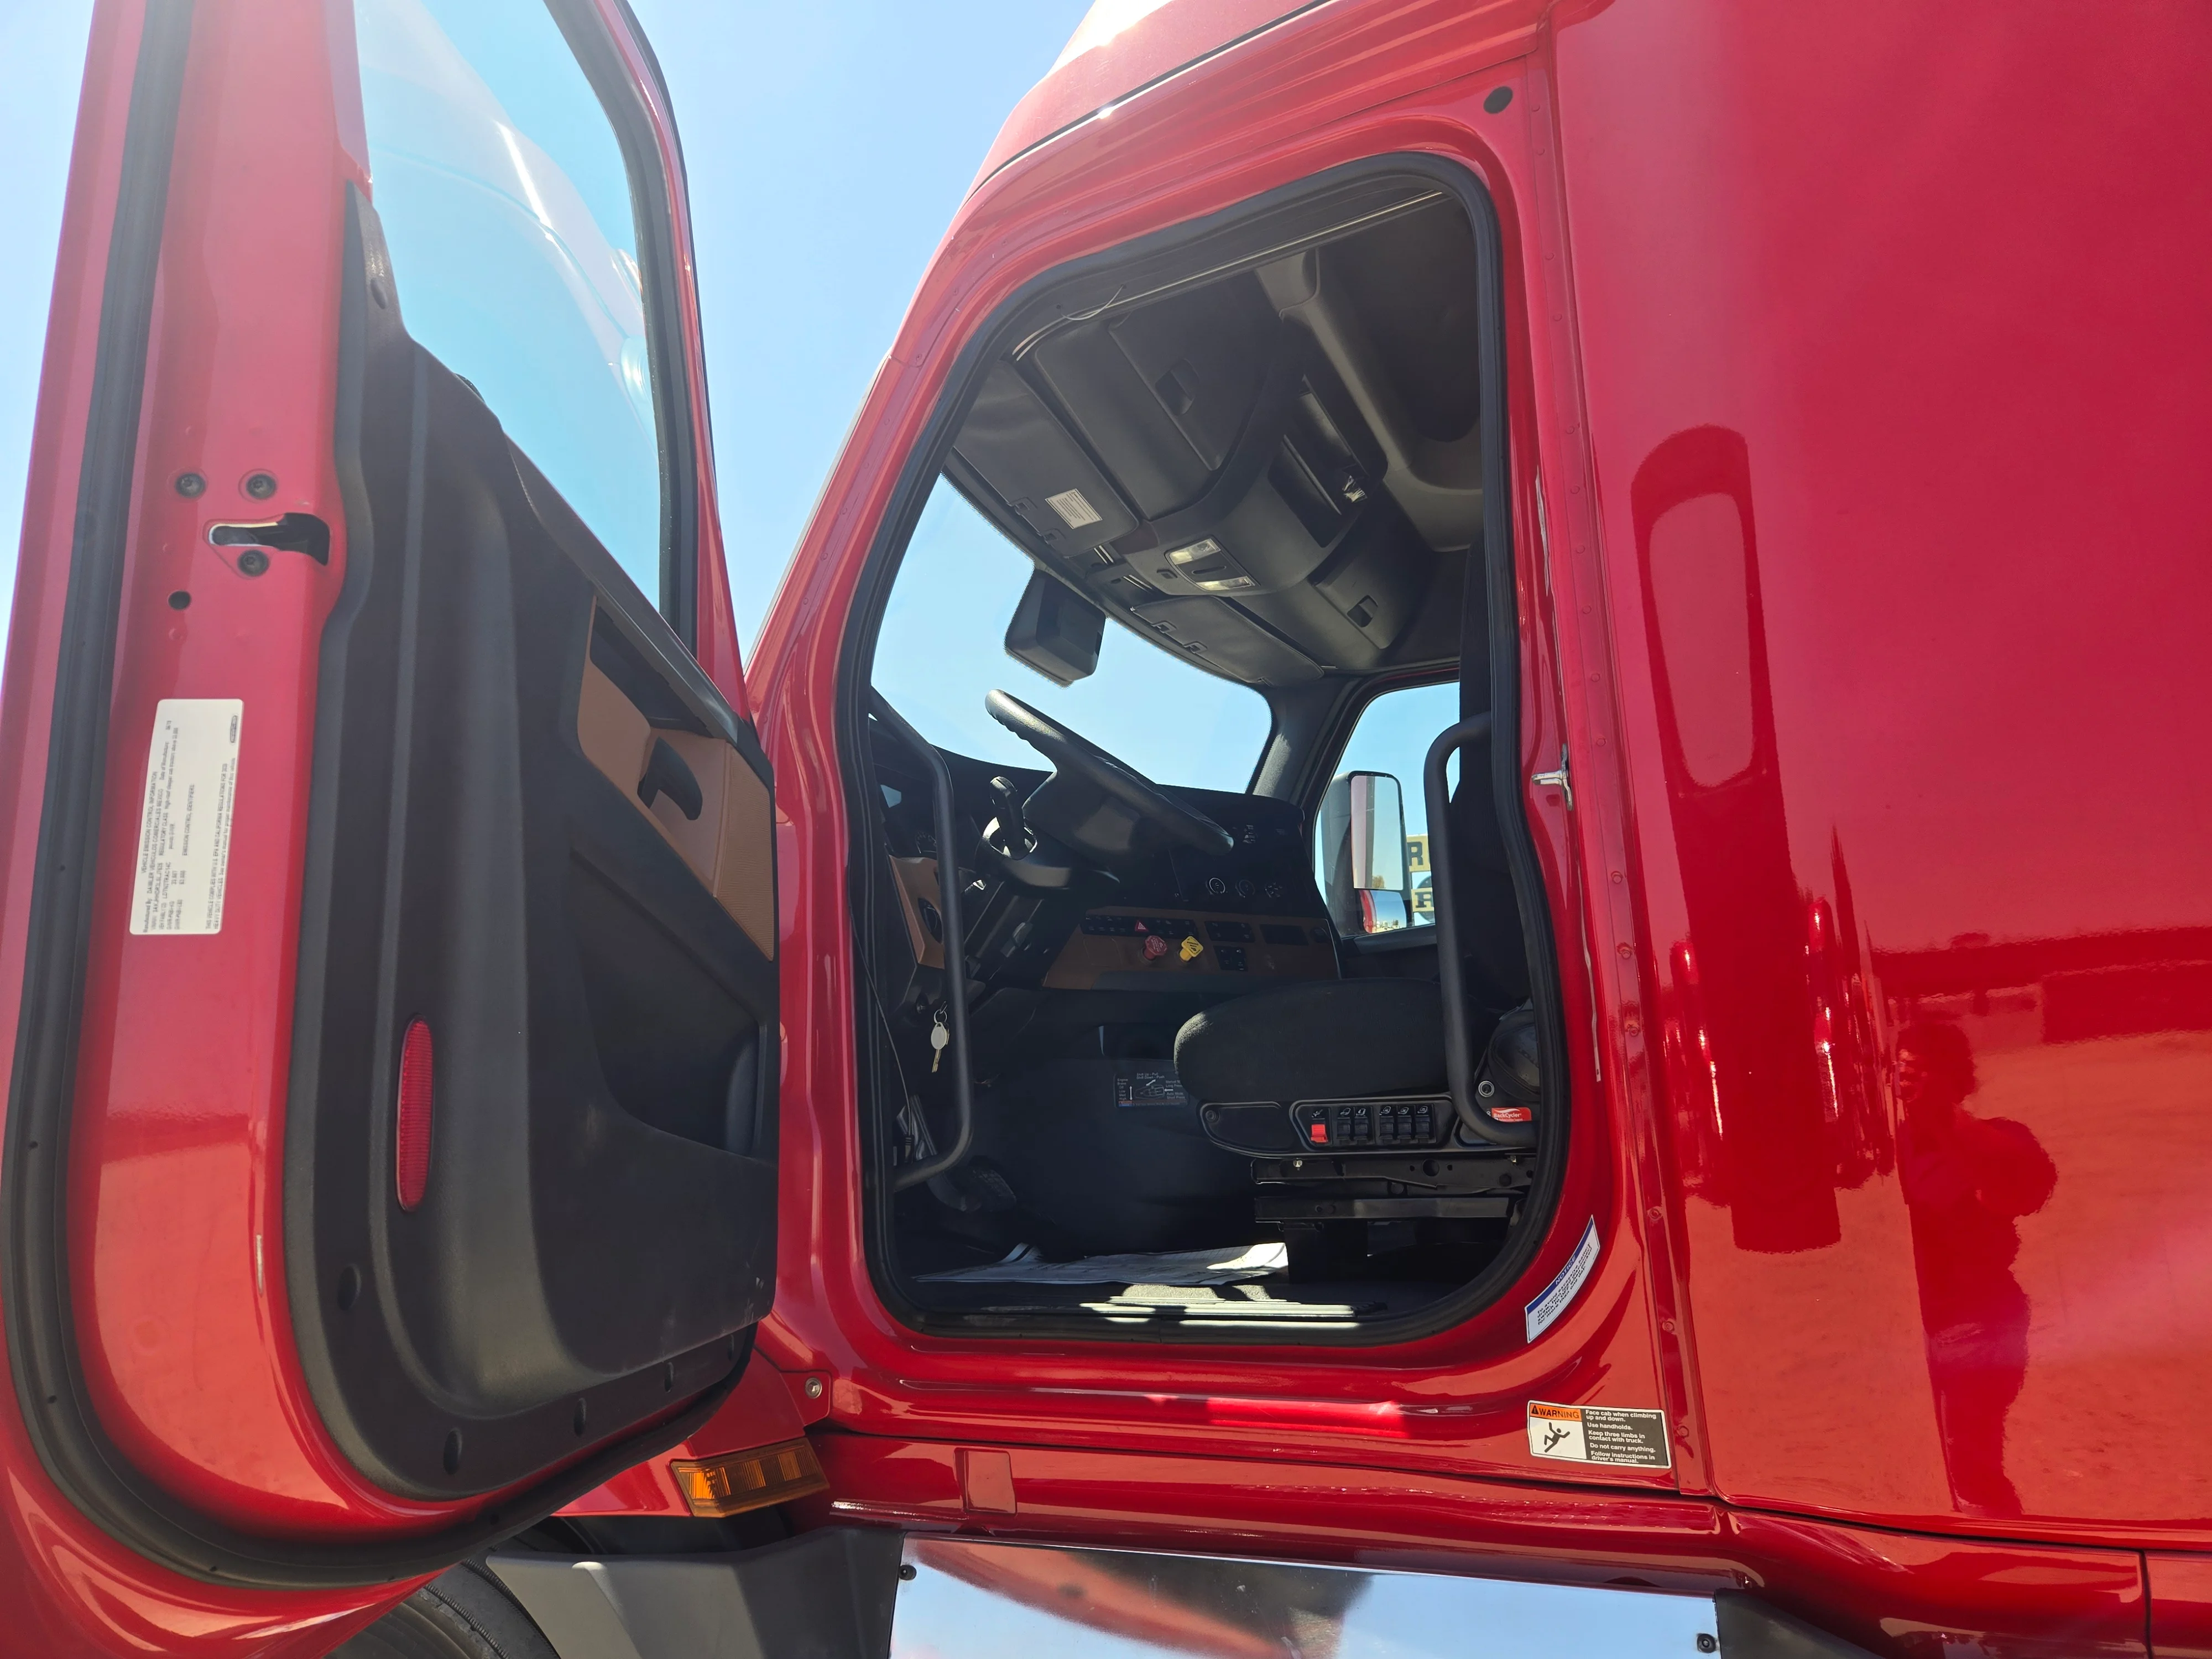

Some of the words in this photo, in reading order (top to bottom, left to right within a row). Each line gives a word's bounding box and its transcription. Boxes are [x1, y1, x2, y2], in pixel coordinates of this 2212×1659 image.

[1556, 1255, 1575, 1285] NOTICE
[1545, 1292, 1557, 1307] avoid
[1558, 1265, 1578, 1292] excessive
[1538, 1306, 1553, 1321] switch
[1561, 1286, 1569, 1298] OFF
[1546, 1304, 1558, 1317] more
[1539, 1407, 1580, 1419] WARNING
